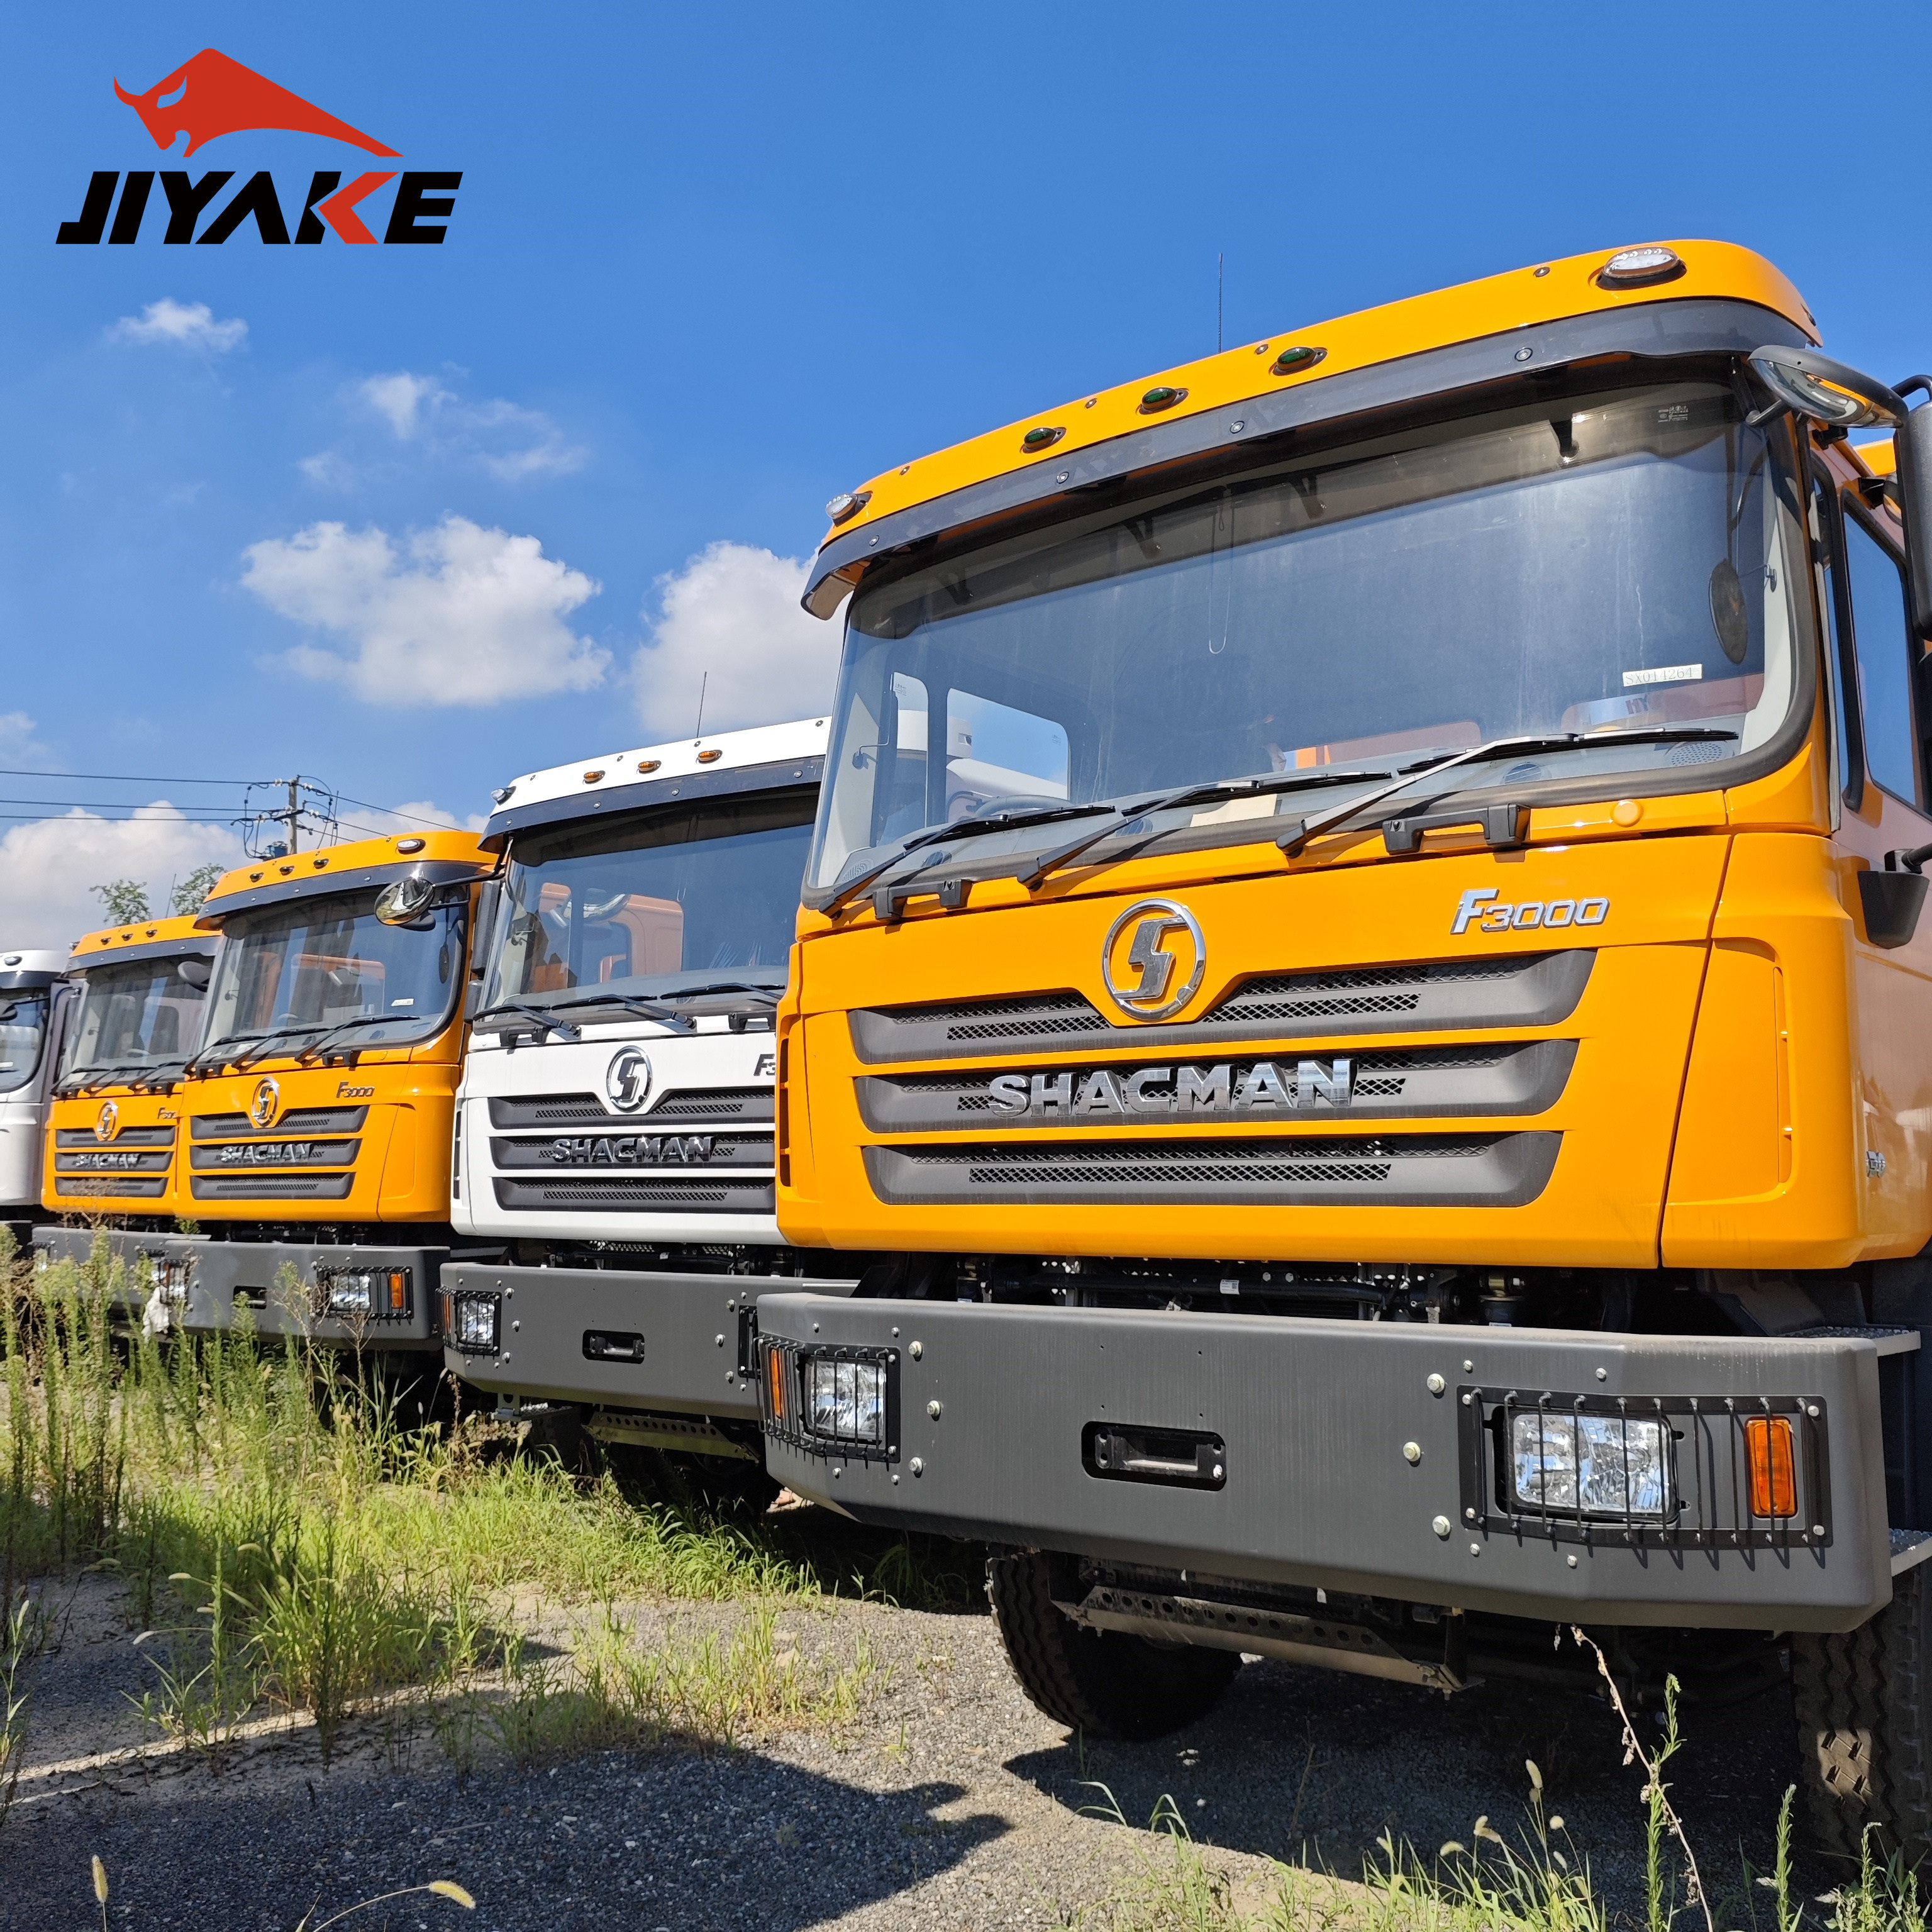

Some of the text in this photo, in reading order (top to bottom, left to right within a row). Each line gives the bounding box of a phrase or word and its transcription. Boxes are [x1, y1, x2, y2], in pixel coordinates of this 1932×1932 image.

[1625, 667, 1693, 685] SX014264
[1450, 888, 1610, 935] F3000
[989, 1058, 1353, 1117] SHACMAN
[552, 1136, 717, 1163] SHACMAN
